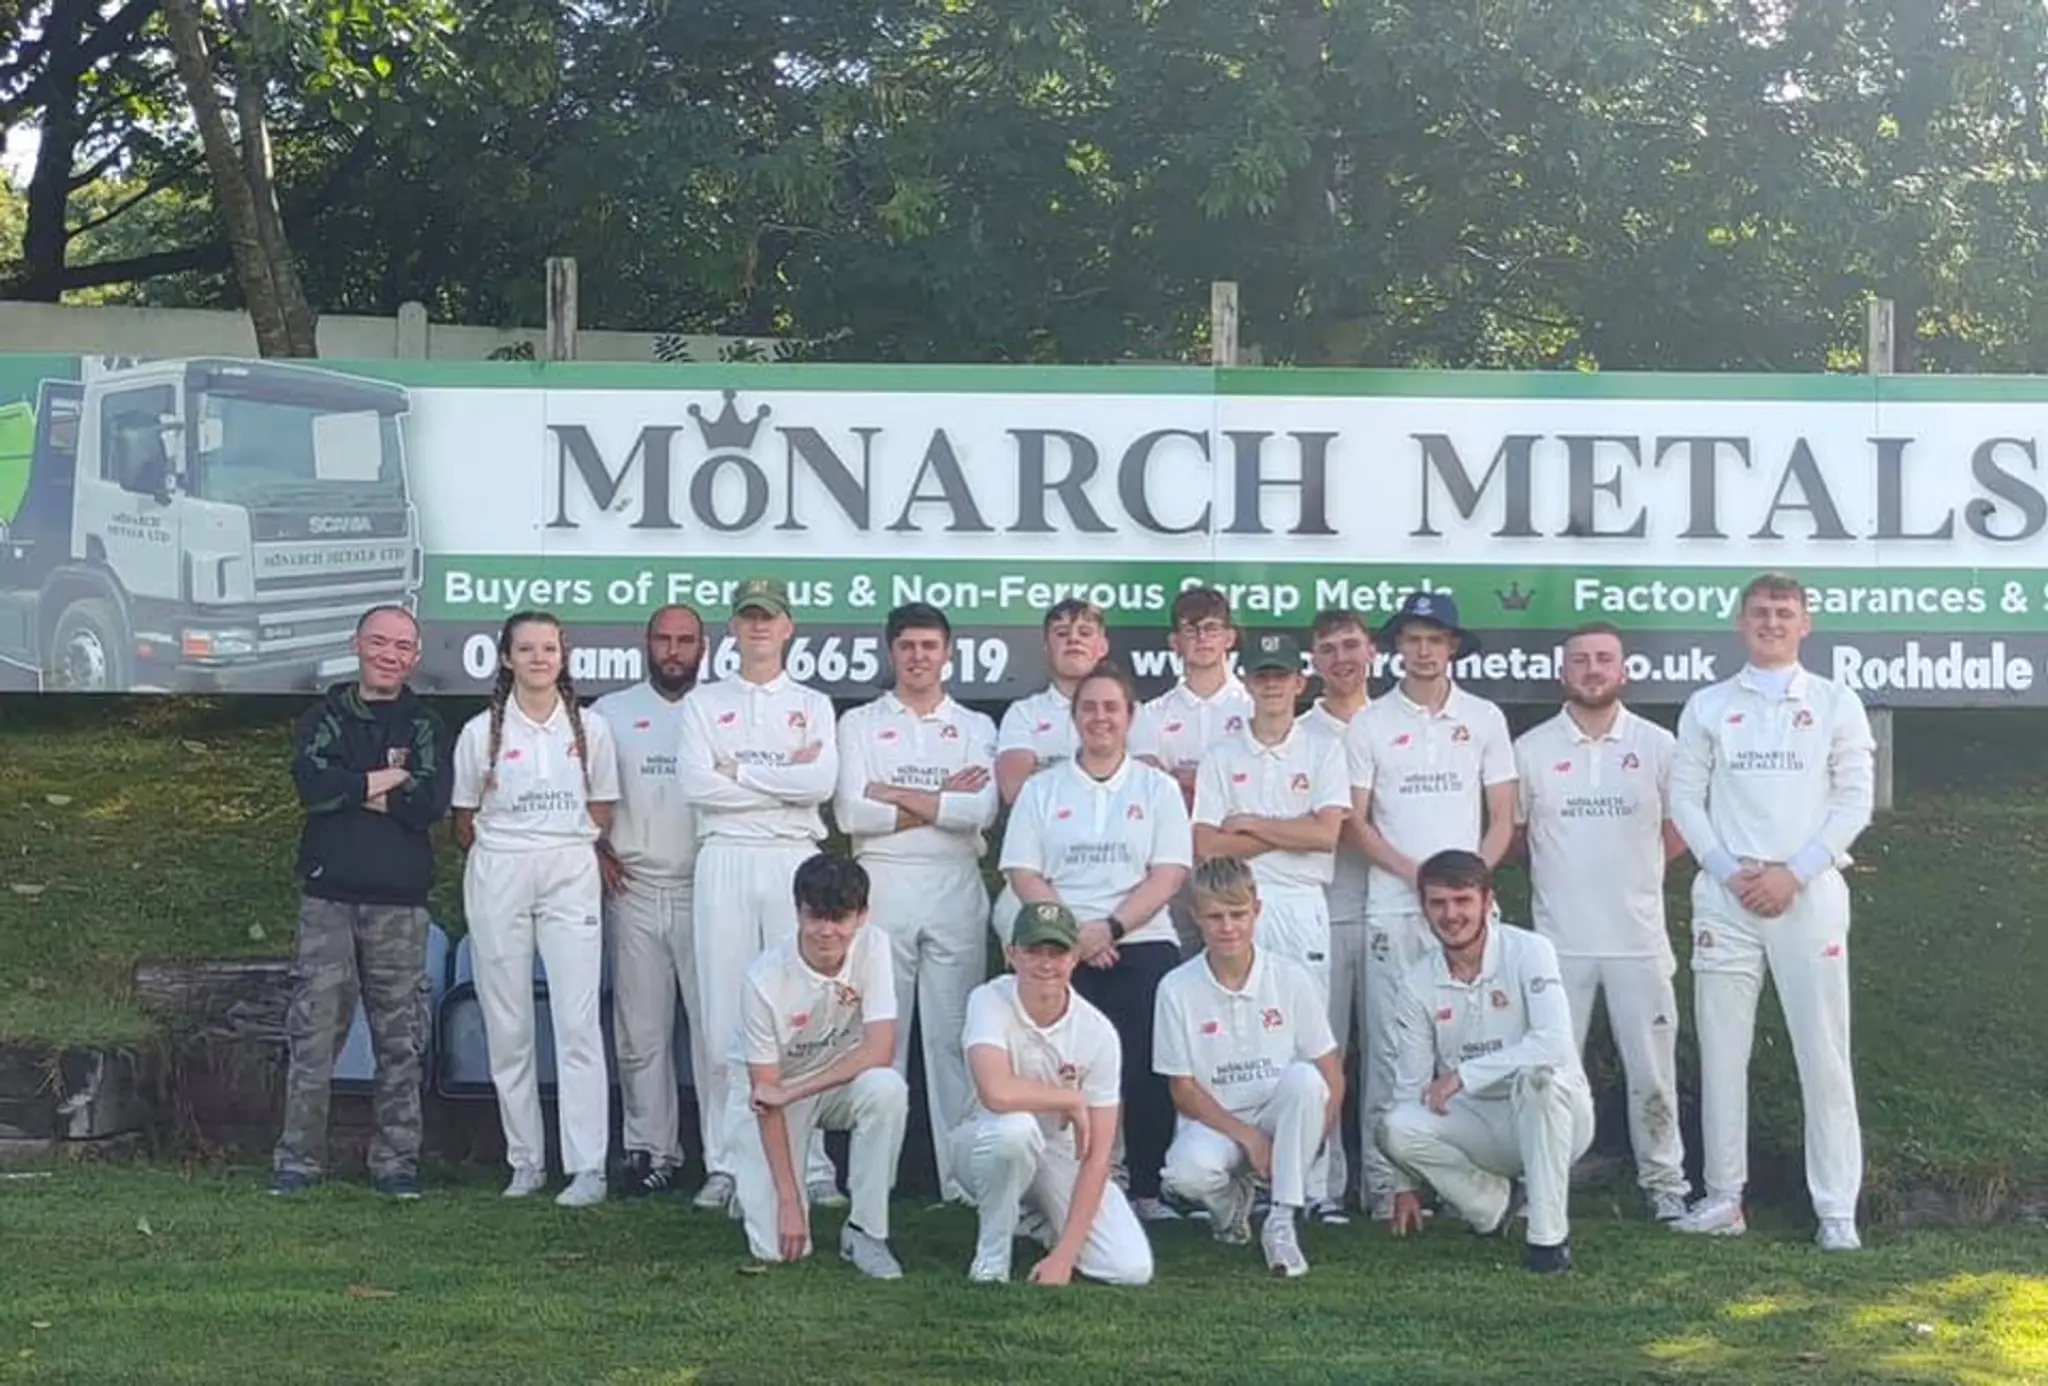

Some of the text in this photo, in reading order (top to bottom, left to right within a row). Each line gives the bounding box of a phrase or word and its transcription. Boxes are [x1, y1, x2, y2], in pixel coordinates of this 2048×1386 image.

[1408, 432, 2047, 542] METALS
[445, 571, 593, 610] Buyers
[607, 572, 653, 606] of
[667, 573, 833, 607] Ferus
[848, 575, 876, 608] &
[892, 576, 1165, 611] Non-Ferrous
[1180, 577, 1300, 617] rap
[1574, 579, 1740, 618] Factory
[1804, 586, 1987, 613] earances
[2000, 580, 2028, 613] &
[786, 637, 879, 682] 665
[1832, 640, 2033, 690] Rochdale
